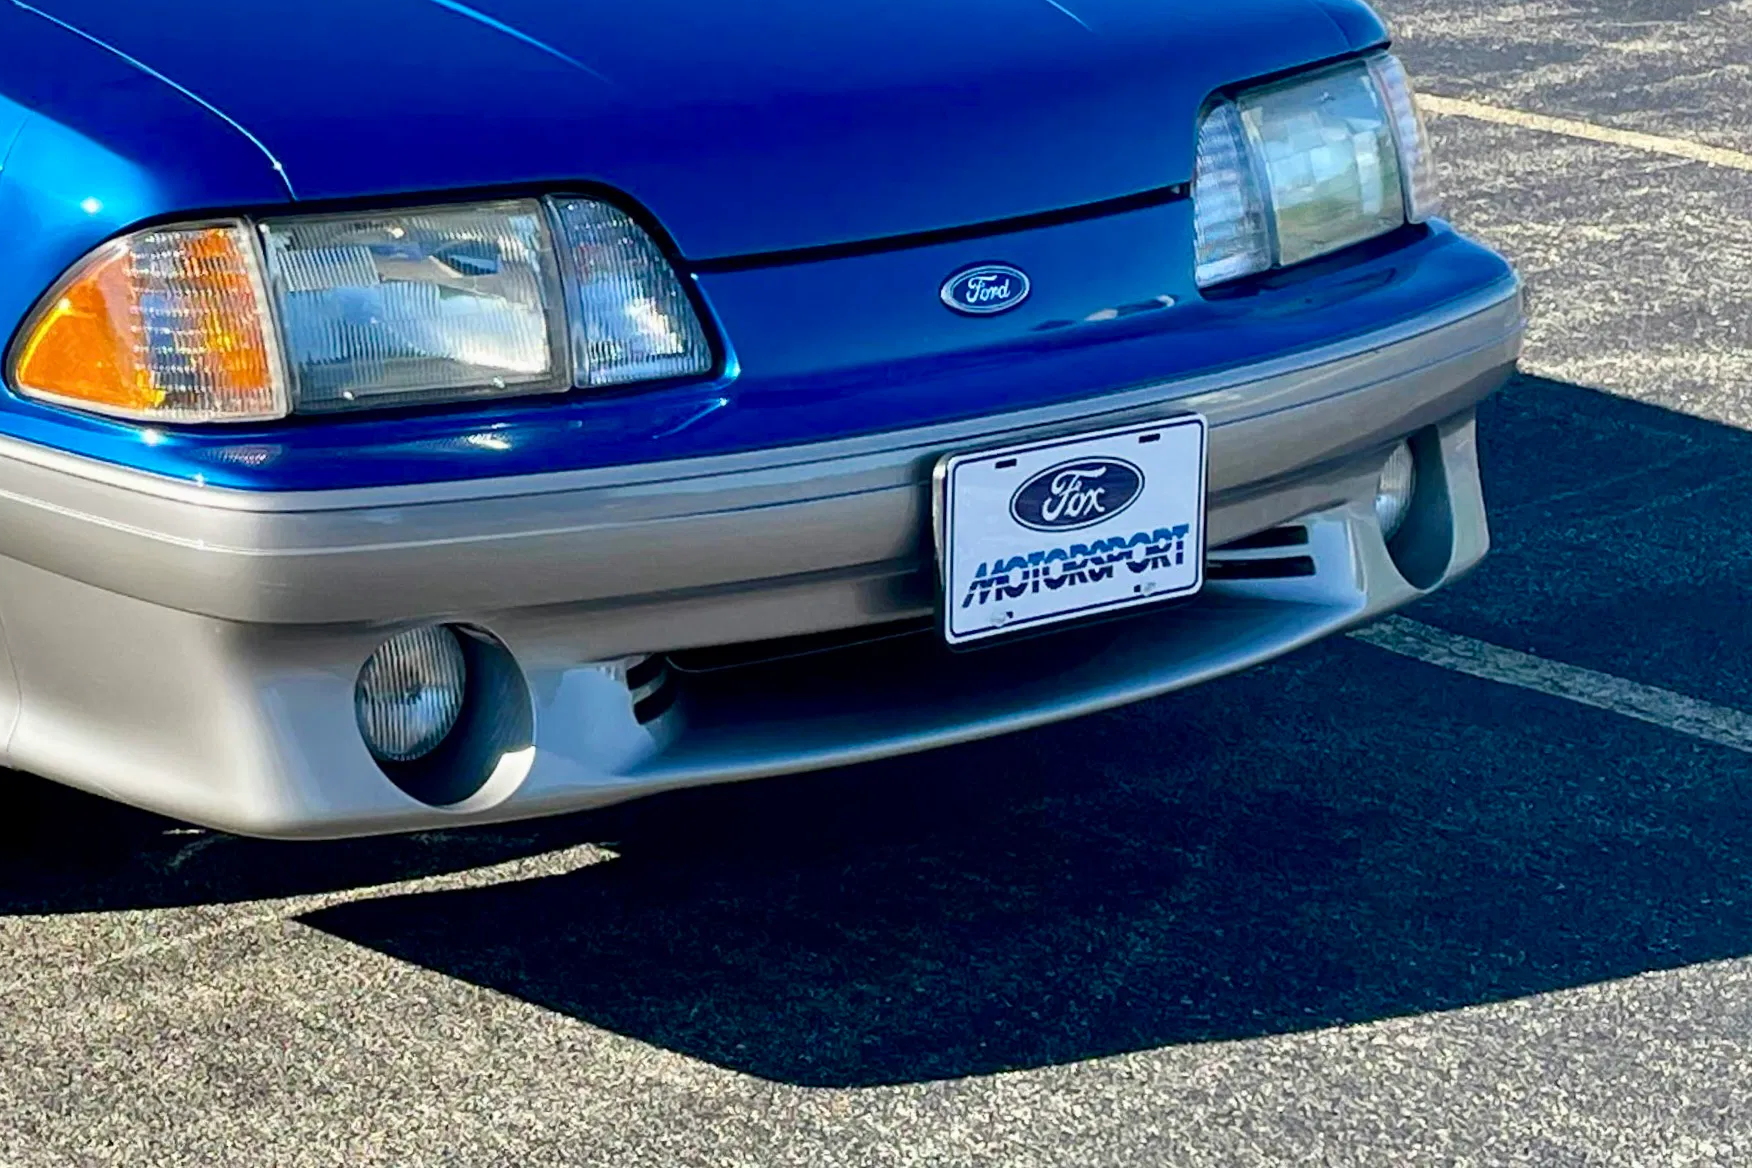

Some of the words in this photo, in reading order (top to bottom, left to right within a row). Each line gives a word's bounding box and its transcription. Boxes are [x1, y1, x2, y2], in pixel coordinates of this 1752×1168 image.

[966, 274, 1011, 303] Ford
[1042, 466, 1107, 521] Fox
[962, 523, 1190, 608] MOTORSPORT
